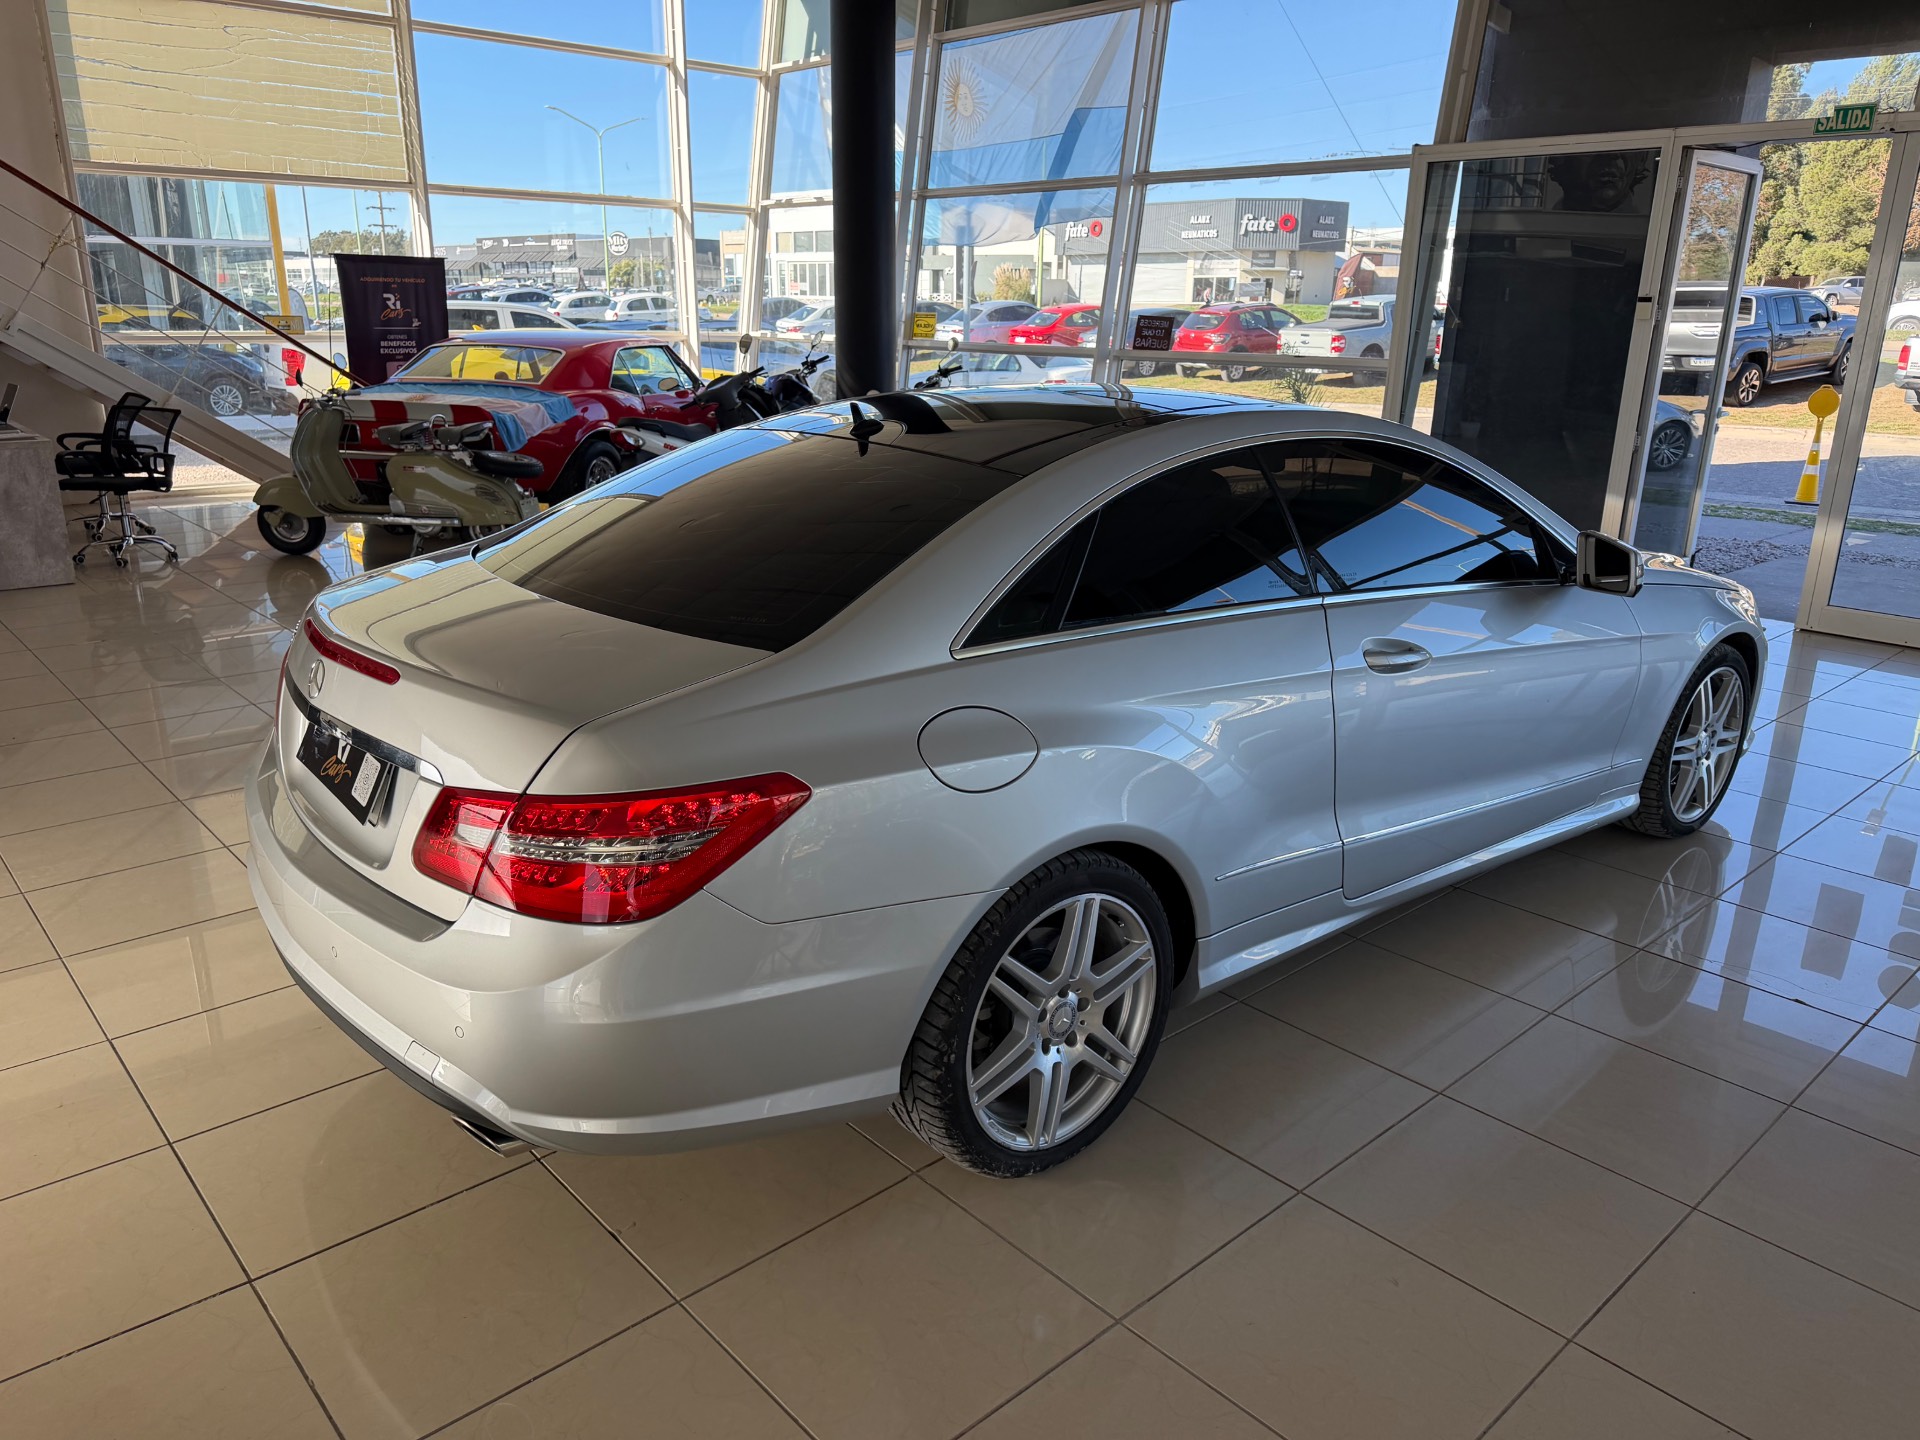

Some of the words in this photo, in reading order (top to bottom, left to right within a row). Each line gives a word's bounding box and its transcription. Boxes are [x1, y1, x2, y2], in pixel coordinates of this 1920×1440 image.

[1817, 109, 1870, 131] SALIDA
[1065, 221, 1089, 241] fate
[1181, 229, 1218, 239] NEUMATICOS
[1240, 213, 1275, 235] fate
[1312, 230, 1339, 239] NEUMATICOS
